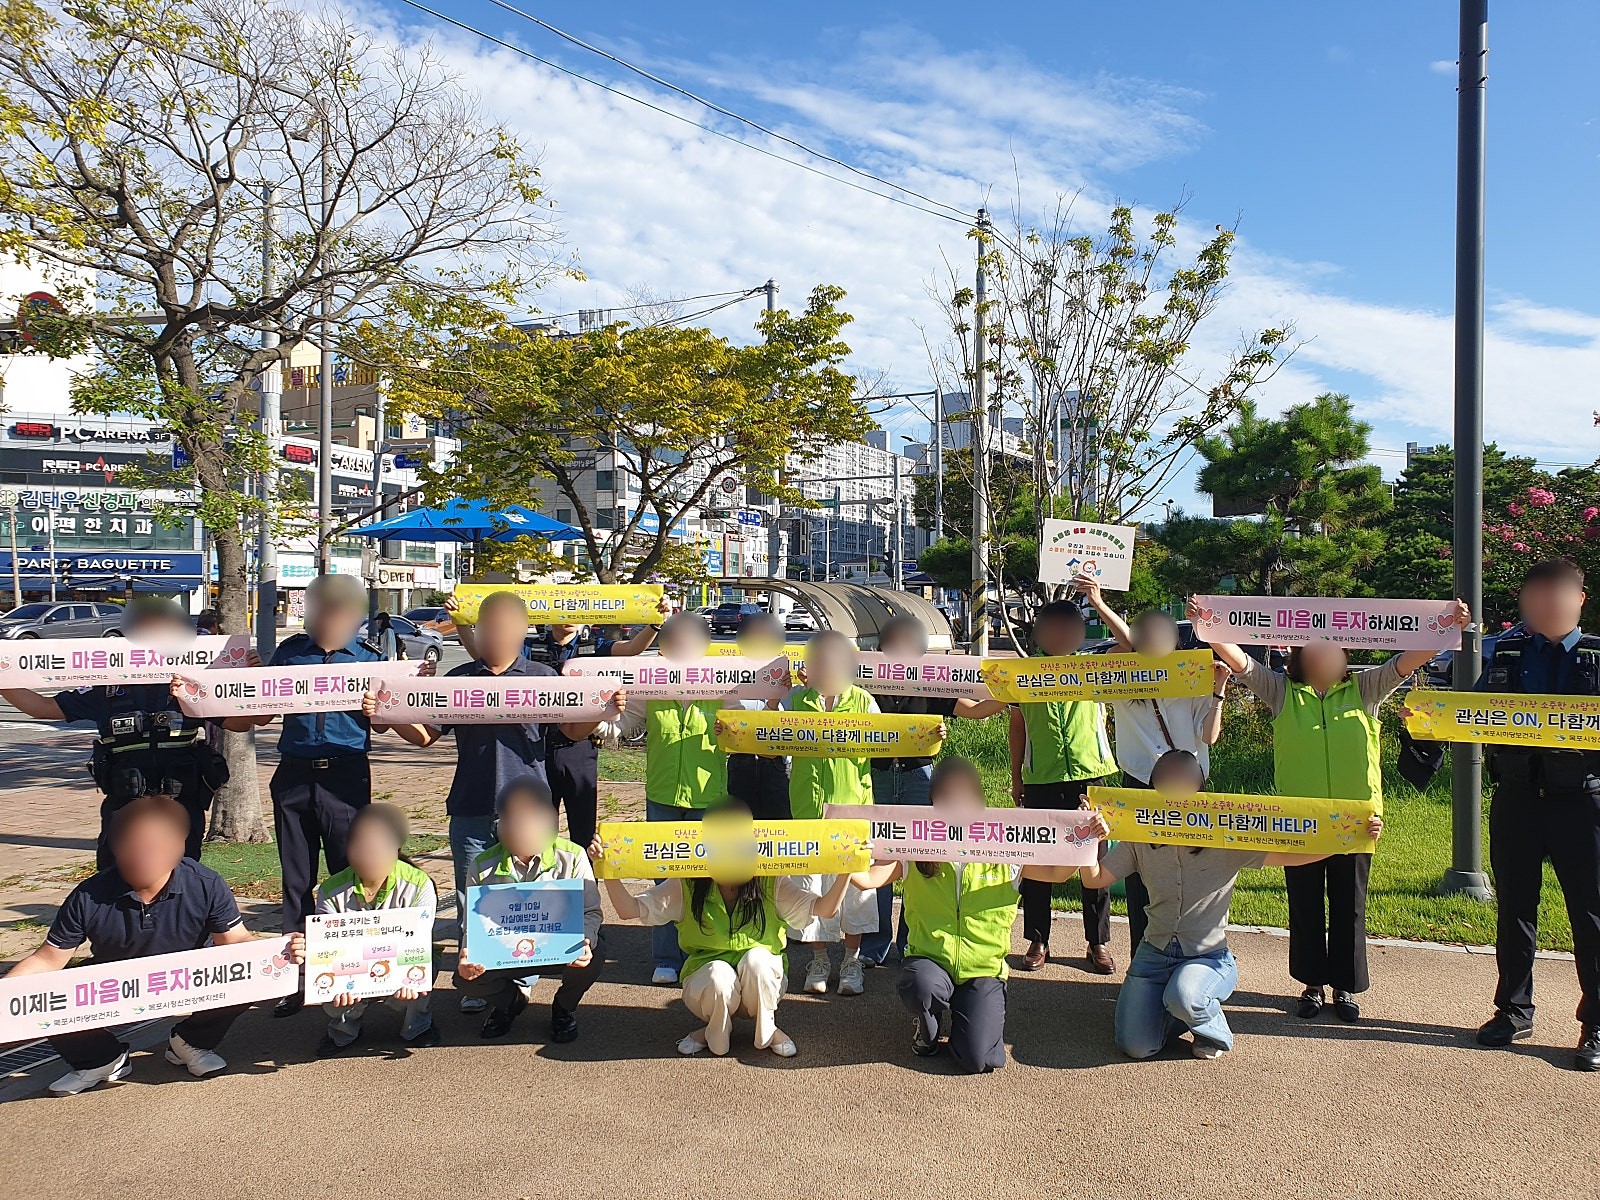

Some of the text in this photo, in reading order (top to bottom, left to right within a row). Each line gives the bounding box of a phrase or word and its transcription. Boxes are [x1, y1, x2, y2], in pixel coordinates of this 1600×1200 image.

[17, 423, 51, 431] RED
[60, 425, 91, 441] PC
[93, 430, 150, 441] ARENA
[286, 446, 313, 457] RED
[42, 459, 80, 469] RED
[85, 463, 102, 472] PC
[725, 482, 735, 490] 50
[77, 559, 171, 570] BAGUETTE
[530, 598, 626, 612] ON, 다함께 HELP!
[1228, 610, 1419, 633] 이제는 마음에 투자하세요!
[18, 653, 66, 671] 이제는
[72, 650, 124, 670] 마음에
[1040, 660, 1140, 670] 당신은 가장 소중한 사람입니다.
[639, 667, 681, 685] 마음에
[685, 667, 756, 685] 투자하세요!
[877, 663, 918, 681] 마음에
[1016, 670, 1168, 688] 관심은 ON, 다함께 HELP!
[214, 681, 257, 699] 이제는
[262, 678, 308, 697] 마음에
[407, 689, 583, 708] 이제는 마음에 투자하세요!
[1489, 698, 1516, 708] 당신은
[1519, 699, 1538, 709] 가장
[1540, 700, 1567, 710] 소중한
[780, 717, 874, 728] 당신은 가장 소중한 사람입니다.
[1456, 709, 1508, 726] 관심은
[1512, 712, 1542, 729] ON,
[756, 727, 899, 744] 관심은 ON, 다함께 HELP!
[1191, 800, 1209, 810] 가장
[1212, 801, 1236, 811] 소중한
[1237, 802, 1284, 813] 사람입니다.
[1135, 808, 1317, 834] 관심은 ON, 다함께 HELP!
[675, 829, 698, 838] 당신은
[912, 820, 963, 842] 마음에
[968, 821, 1057, 845] 투자하세요!
[643, 843, 692, 861] 관심은
[777, 842, 819, 857] HELP!
[508, 901, 541, 912] 9월 10일
[324, 916, 381, 929] 생명을 지키는 힘
[501, 911, 549, 924] 자살예방의 날
[324, 931, 339, 940] 우리
[341, 929, 364, 938] 모두의
[487, 922, 562, 937] 소중한 생명을 지켜요
[9, 961, 252, 1017] 이제는 마음에 투자하세요!
